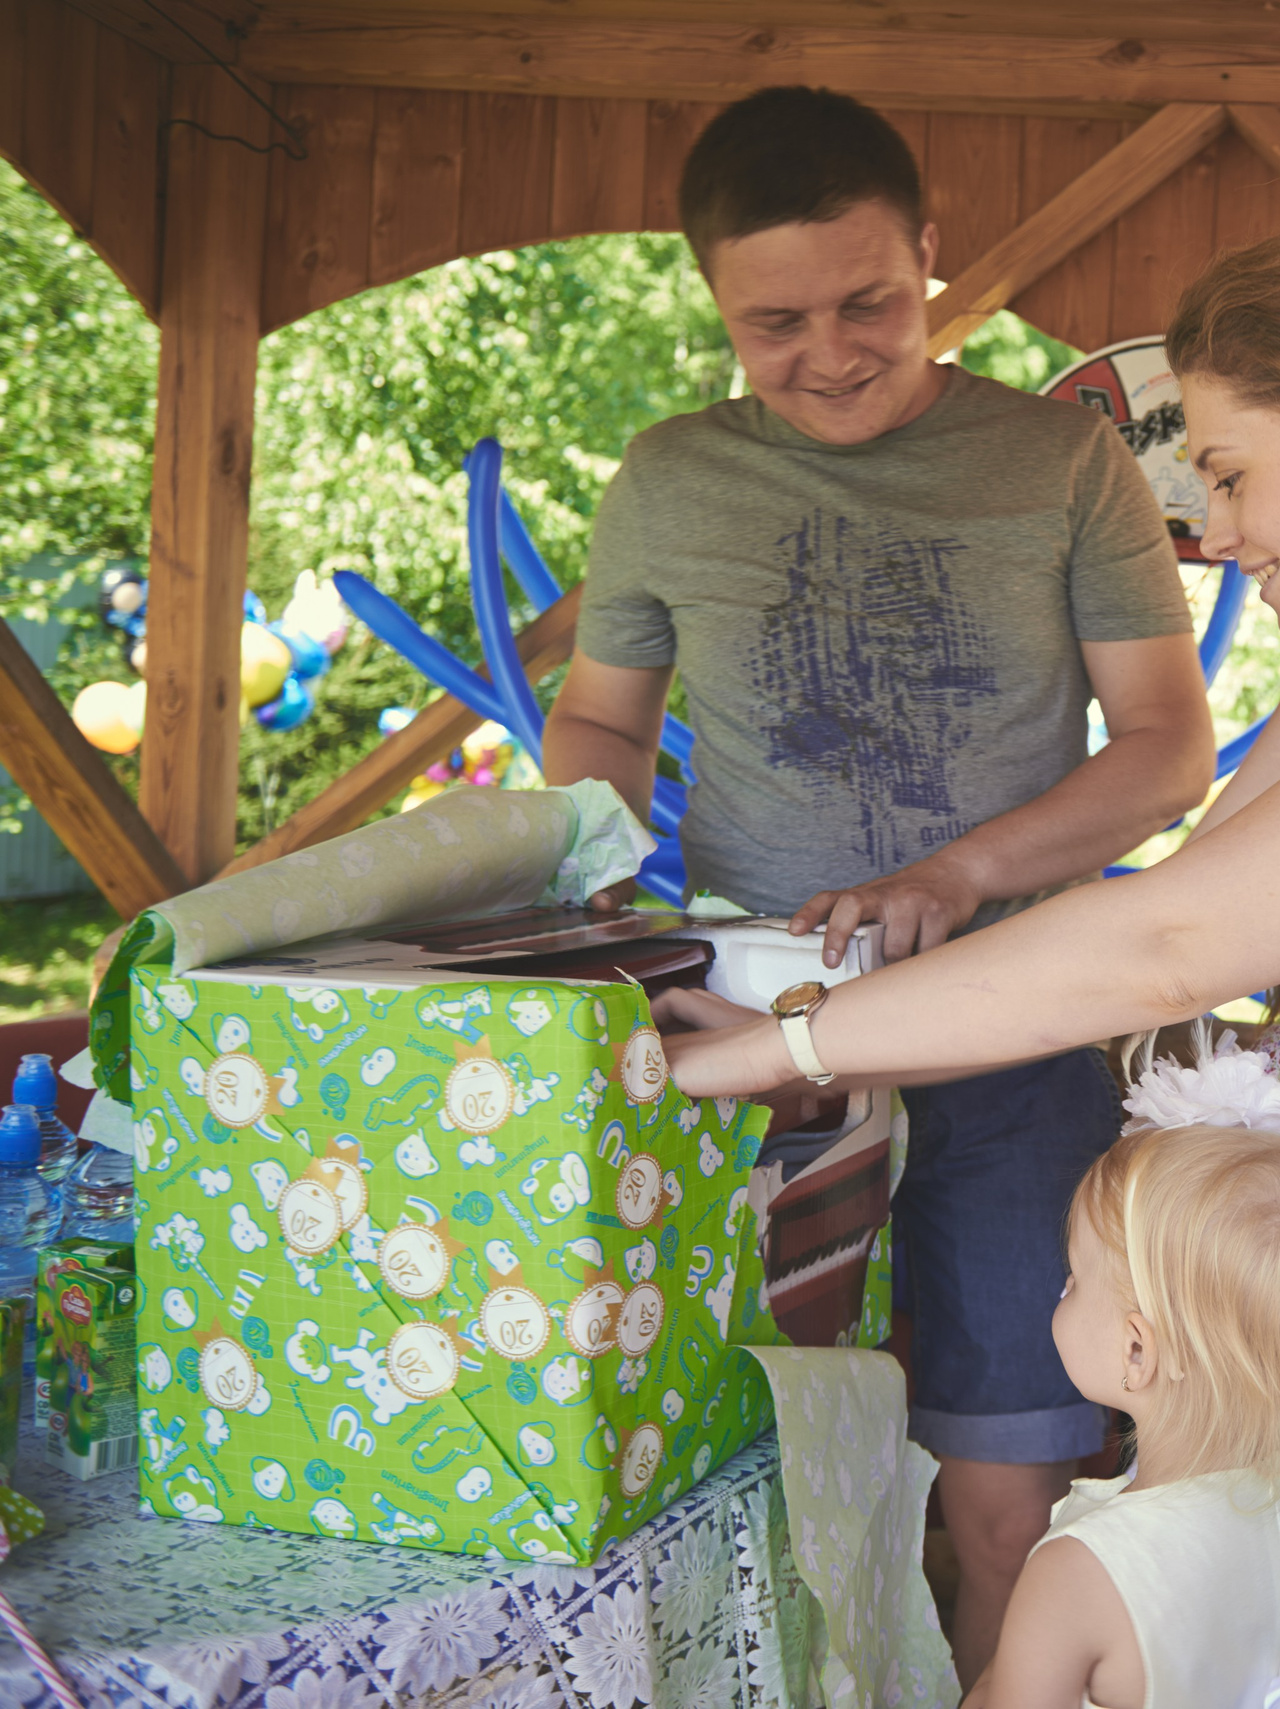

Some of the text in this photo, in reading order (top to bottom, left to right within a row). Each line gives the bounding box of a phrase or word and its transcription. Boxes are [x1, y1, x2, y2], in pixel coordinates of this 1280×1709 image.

[642, 1048, 663, 1086] 20
[214, 1070, 239, 1107] 20
[462, 1090, 496, 1123] 20
[623, 1167, 647, 1208] 20
[290, 1209, 323, 1243] 20
[388, 1249, 423, 1287] 20
[500, 1318, 534, 1348] 20
[637, 1301, 658, 1337] 20
[653, 1308, 681, 1385] Imaginarium
[216, 1365, 246, 1399] 20
[396, 1346, 434, 1385] 20
[380, 1468, 450, 1513] Imaginarium
